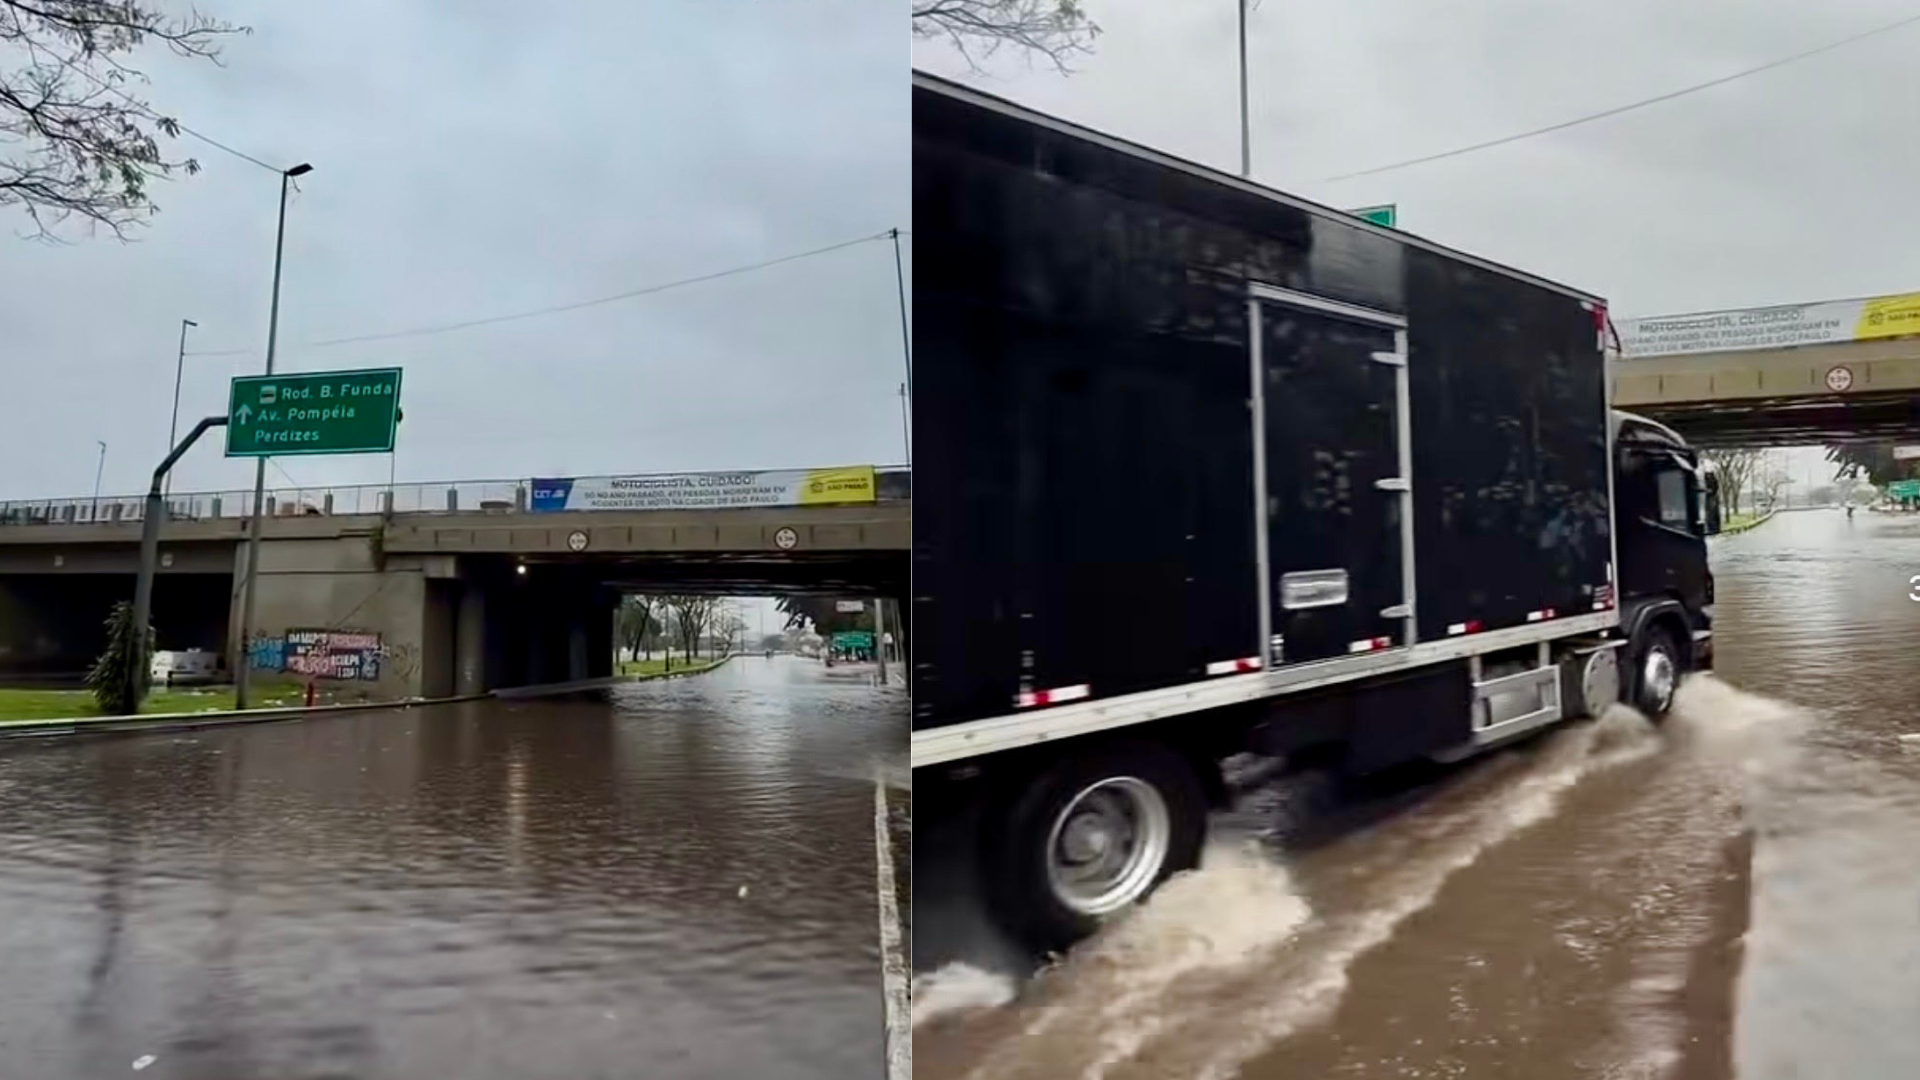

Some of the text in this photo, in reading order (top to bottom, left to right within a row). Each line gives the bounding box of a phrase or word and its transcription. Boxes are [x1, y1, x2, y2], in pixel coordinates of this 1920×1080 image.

[281, 383, 393, 400] Rod. B. Funda
[257, 404, 356, 422] Av. Pompéia
[254, 429, 320, 443] Perdizes
[611, 478, 696, 489] MOTOCICLISTA,
[647, 498, 671, 506] MOTO
[749, 494, 779, 503] PAULO
